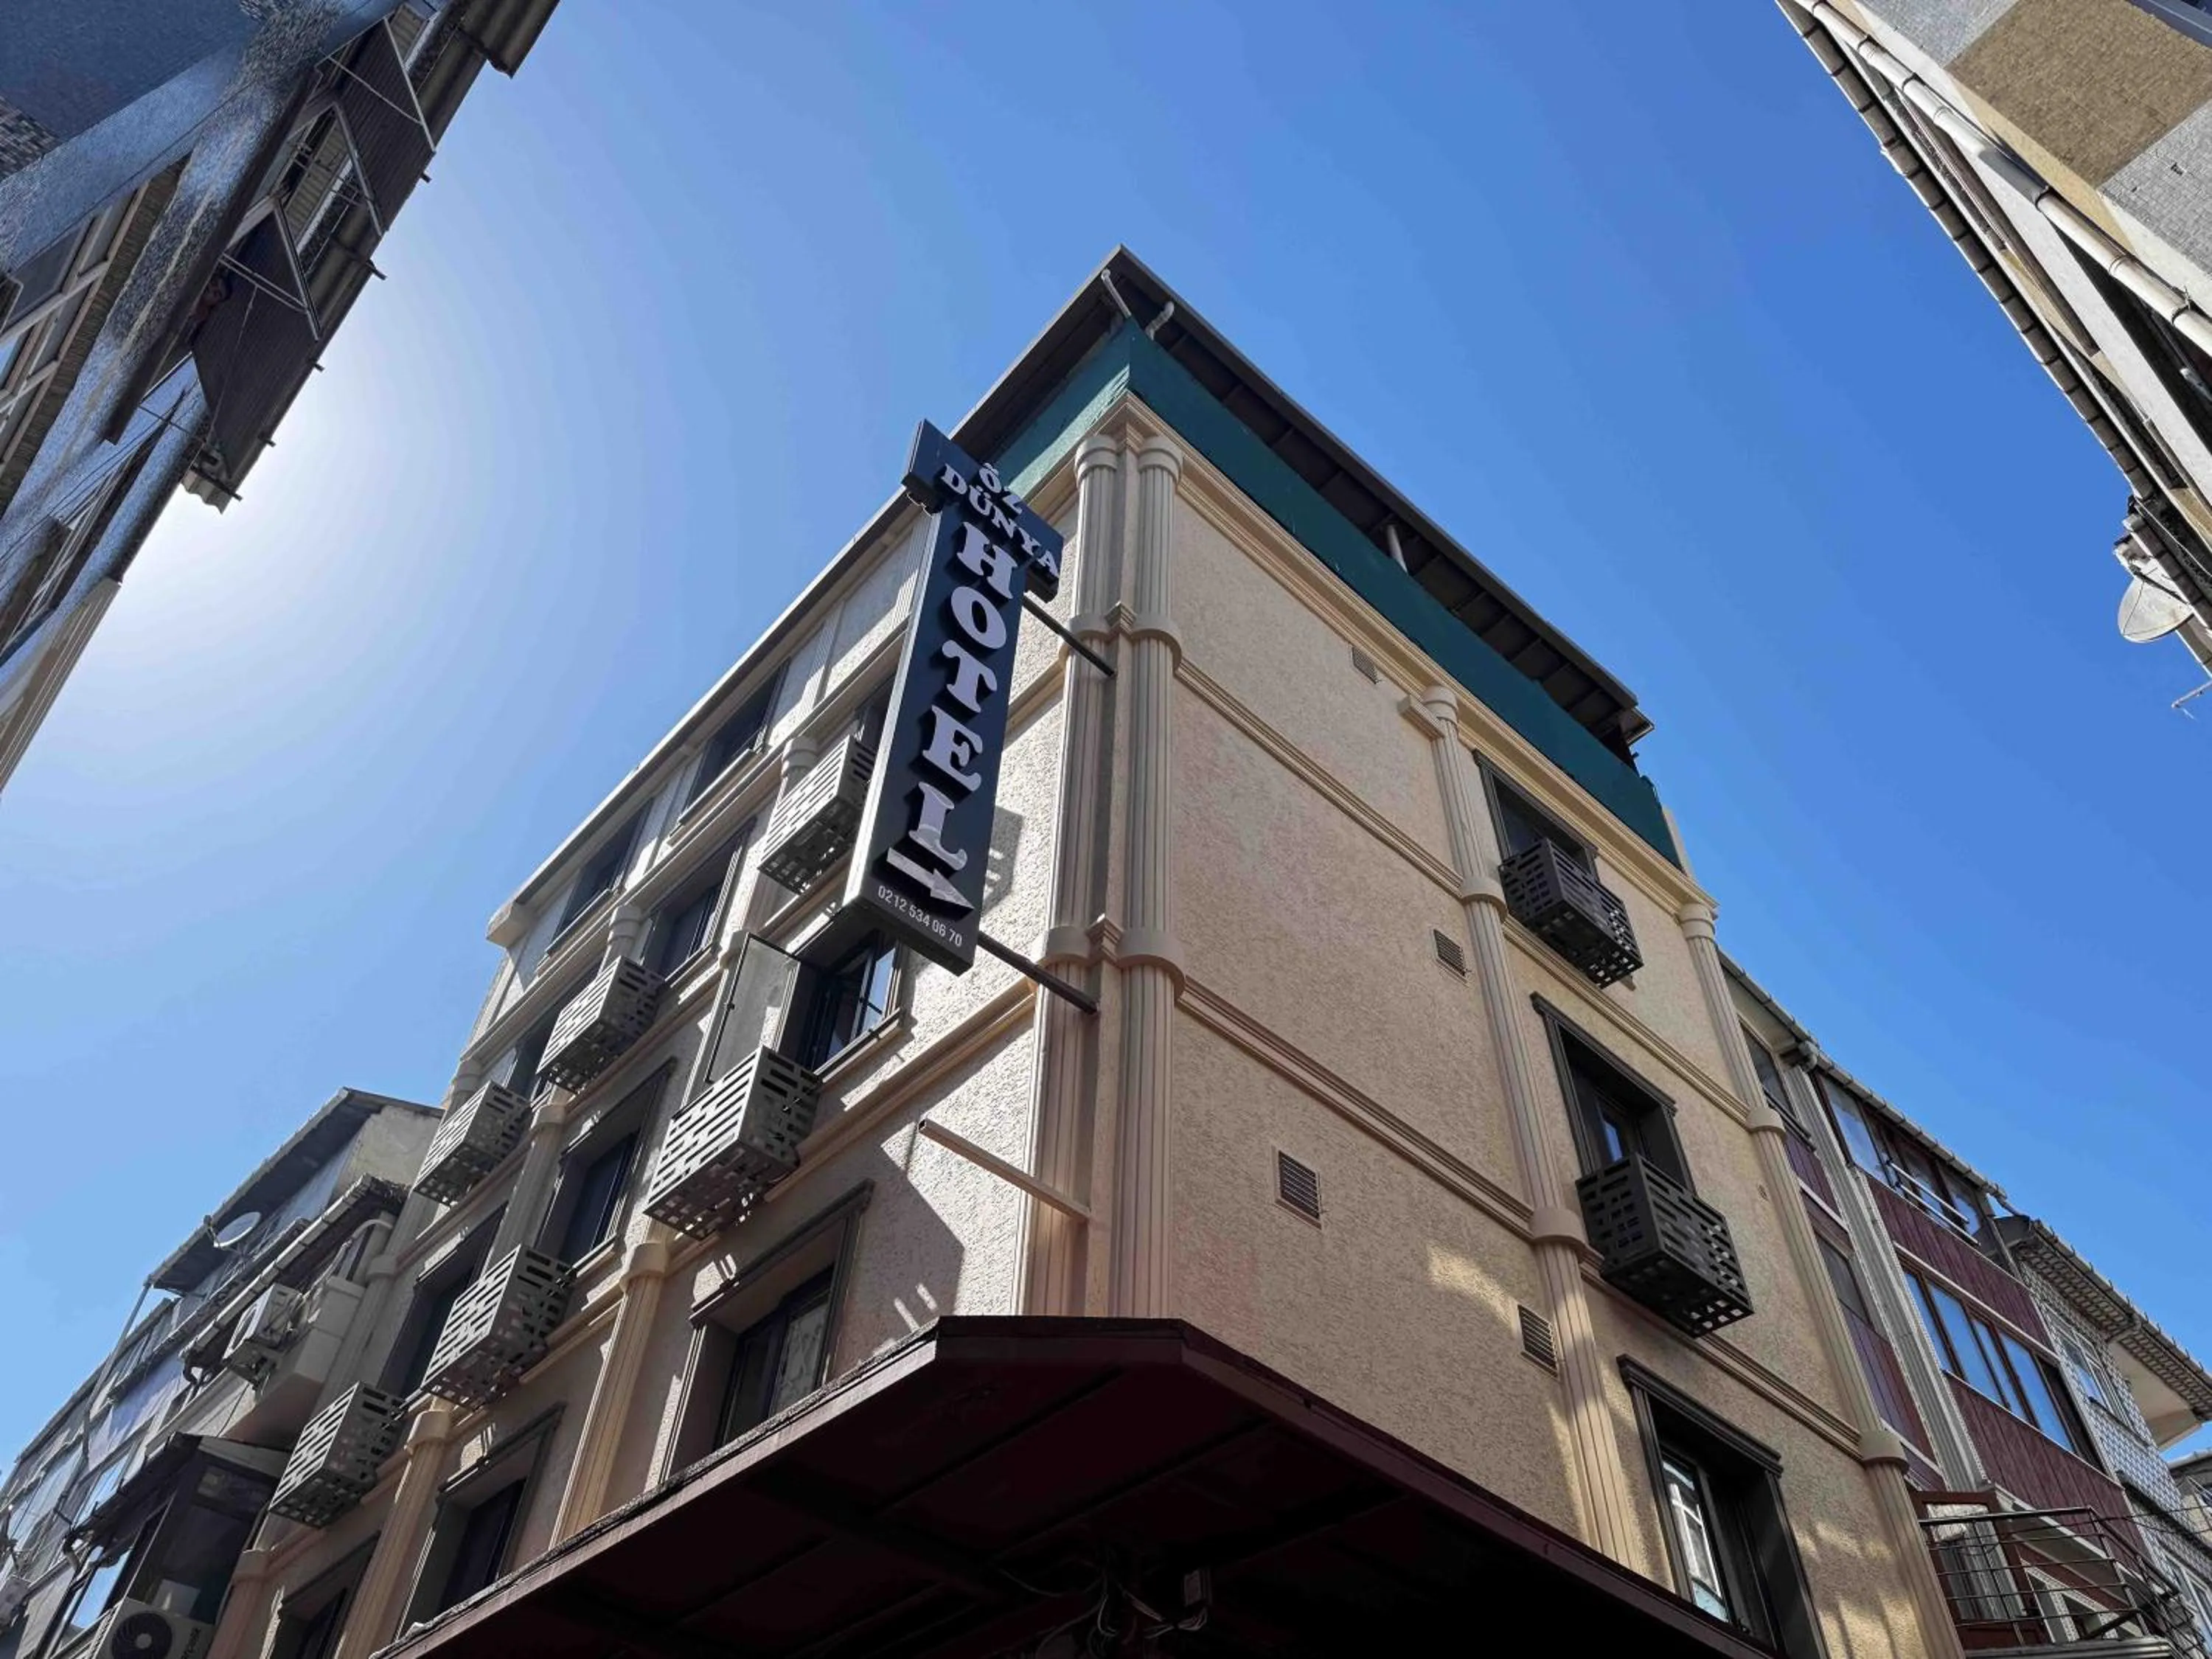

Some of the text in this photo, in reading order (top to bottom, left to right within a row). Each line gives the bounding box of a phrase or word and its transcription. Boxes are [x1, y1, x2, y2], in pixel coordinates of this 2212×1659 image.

[940, 463, 1060, 579] DÜNYA
[908, 521, 1018, 871] HOTEL
[878, 885, 962, 947] 0212 534 06 70
